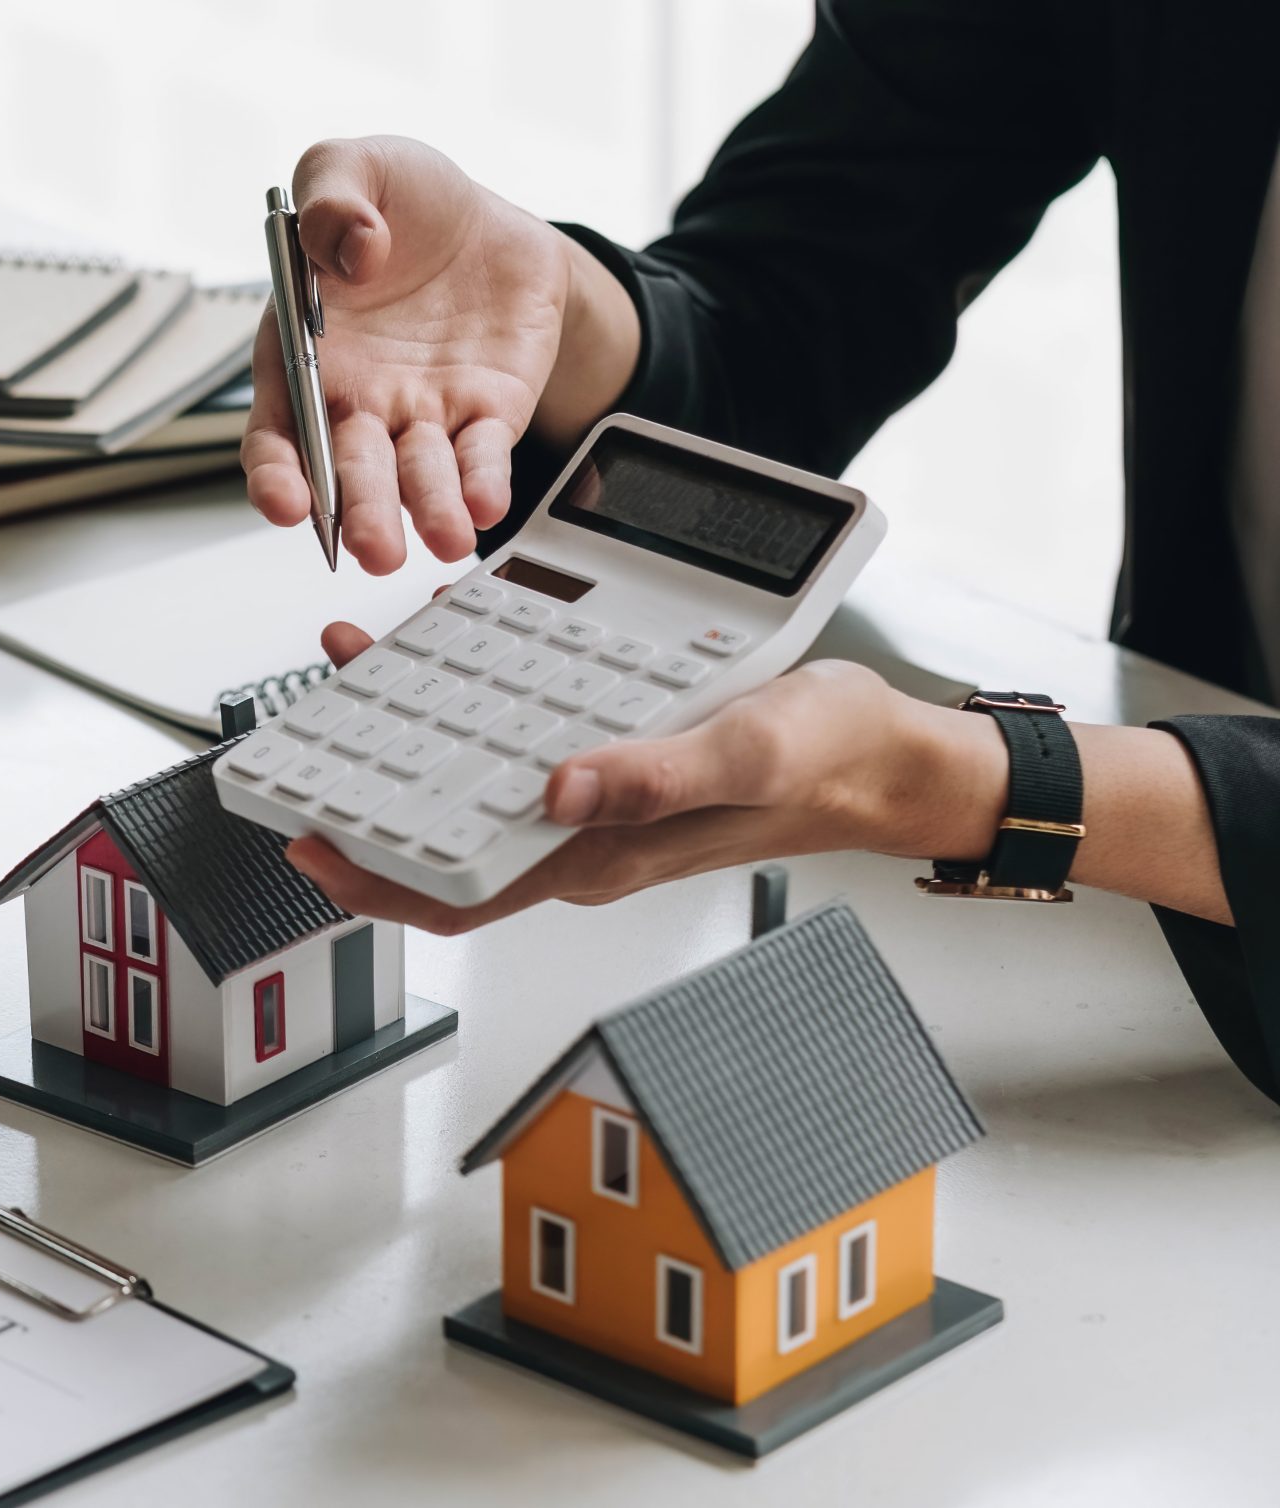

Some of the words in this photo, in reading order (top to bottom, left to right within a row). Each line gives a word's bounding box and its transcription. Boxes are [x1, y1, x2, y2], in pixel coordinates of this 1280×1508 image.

[421, 622, 438, 634] 7
[470, 640, 488, 653] 8
[368, 664, 383, 675] 4
[519, 658, 537, 672] 9
[312, 705, 326, 718] 1
[463, 701, 482, 715] 6
[356, 724, 375, 737] 2
[253, 746, 271, 760] 0
[405, 743, 425, 757] 3
